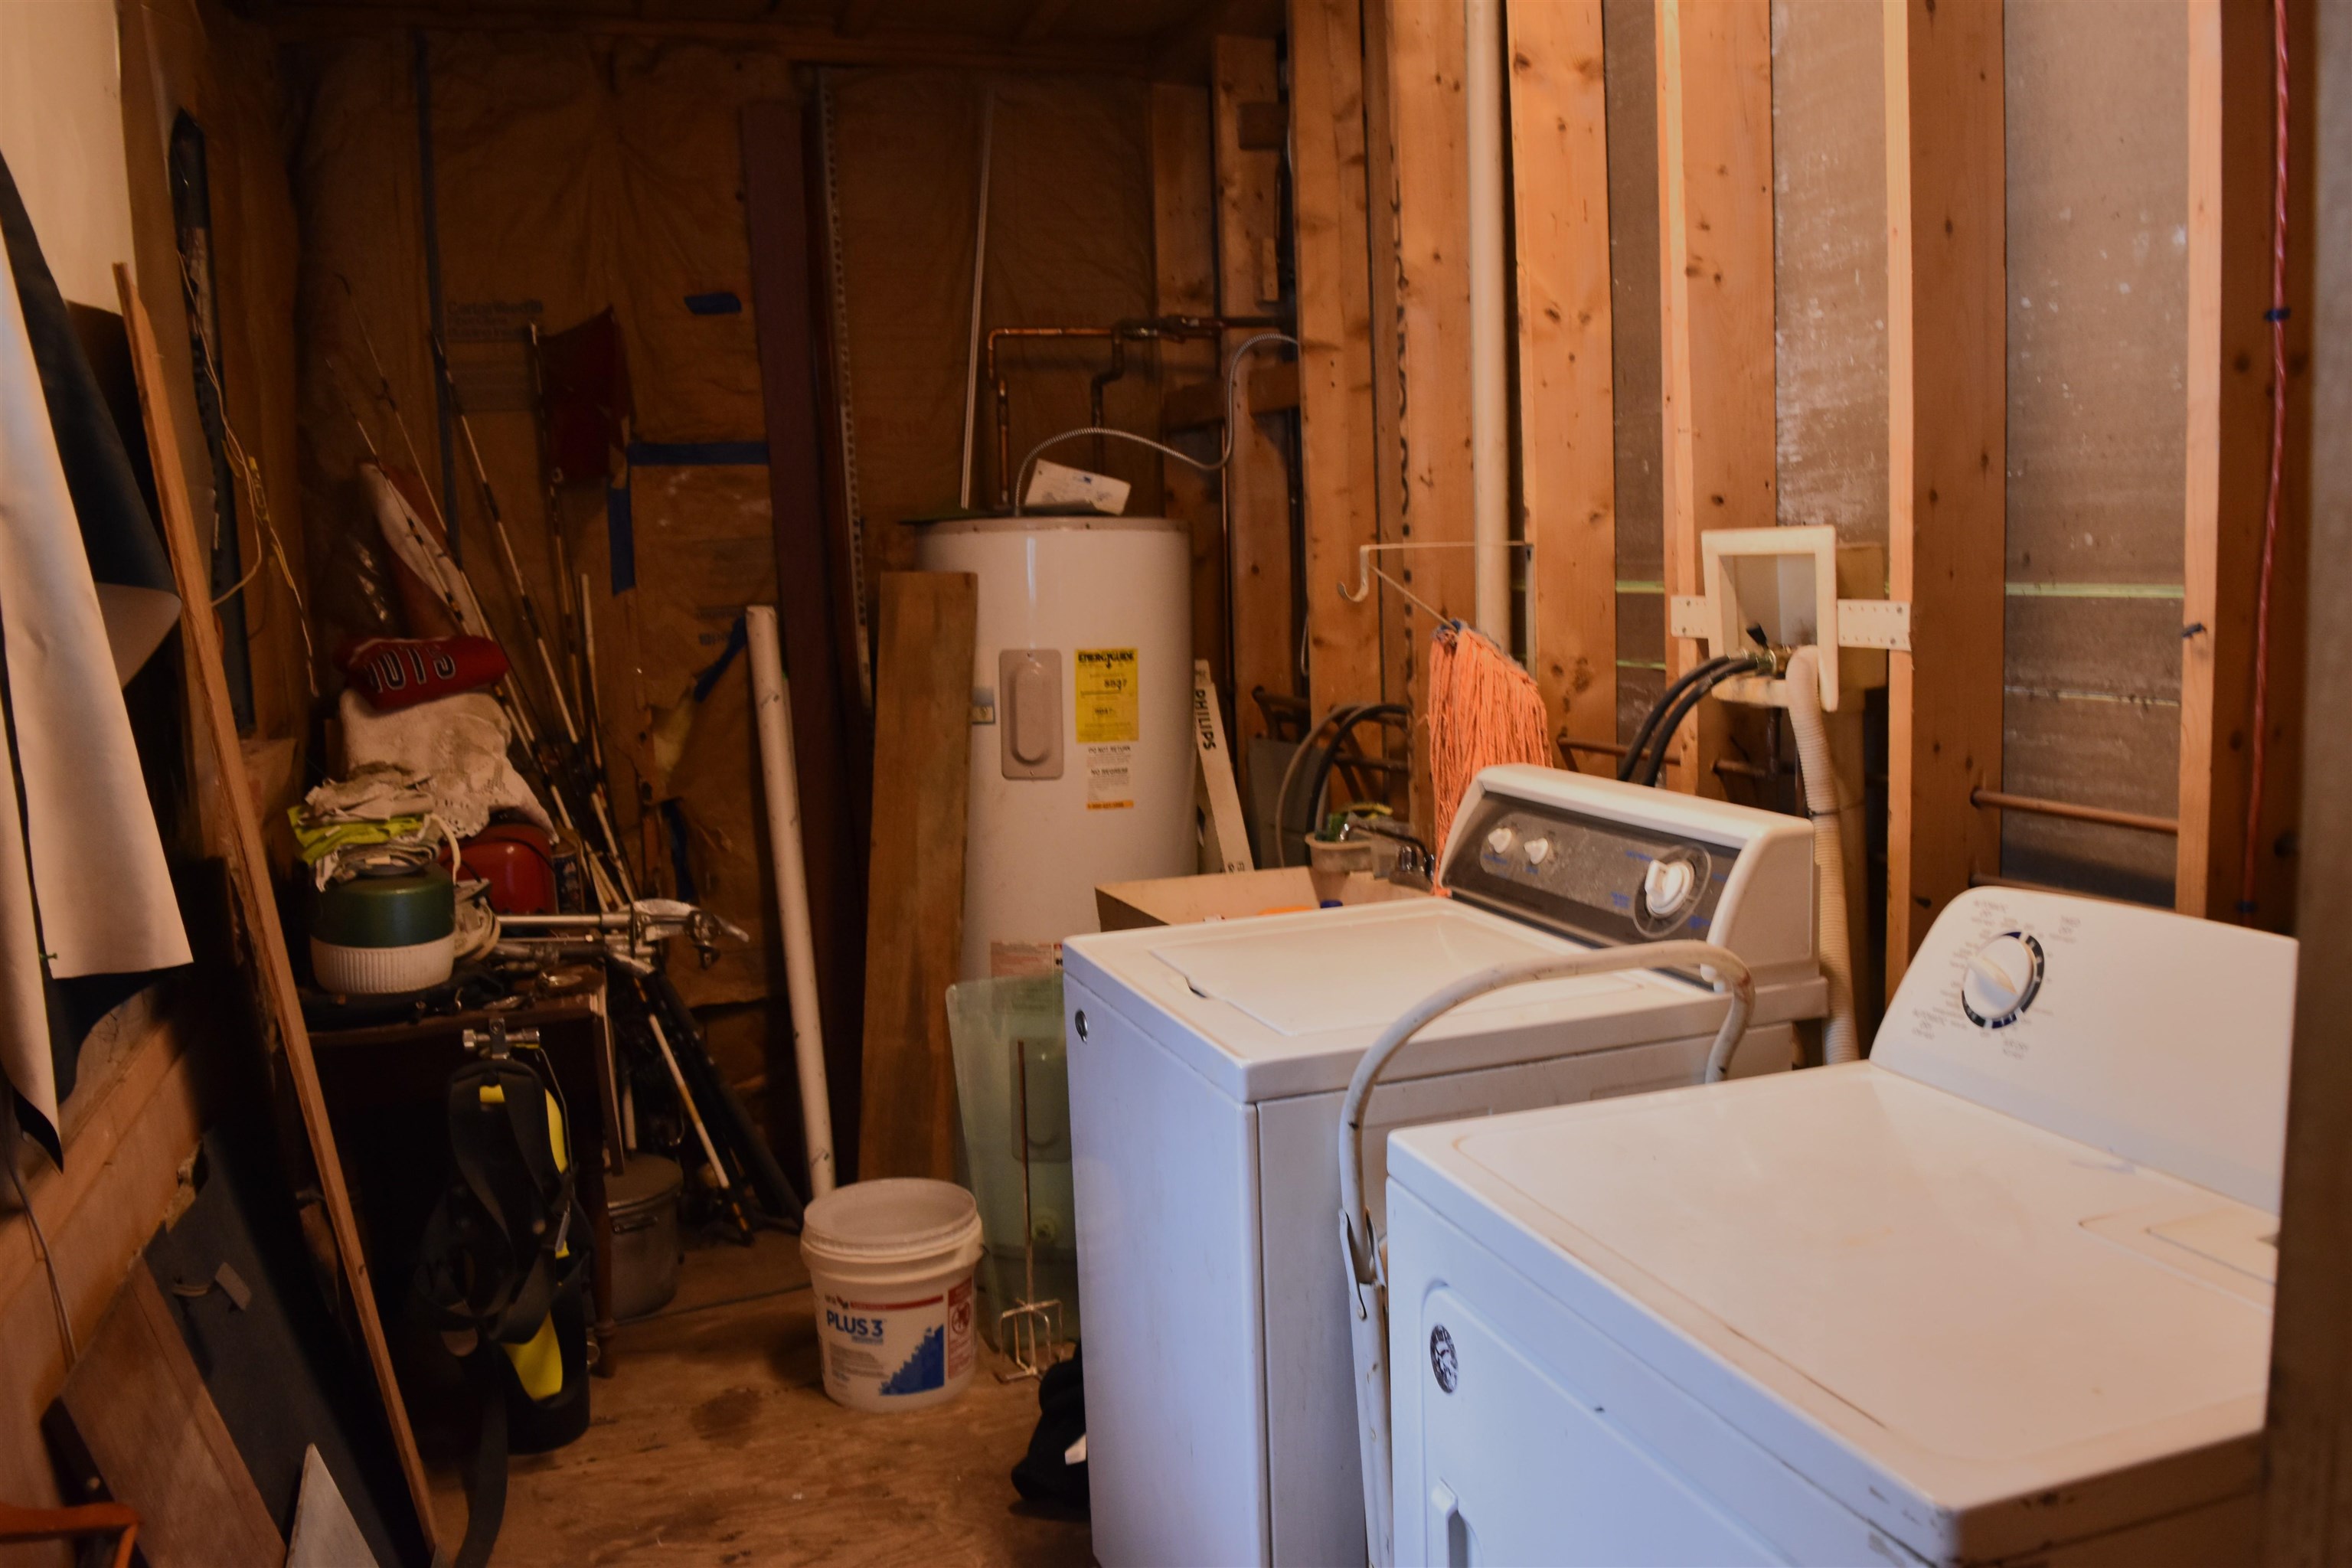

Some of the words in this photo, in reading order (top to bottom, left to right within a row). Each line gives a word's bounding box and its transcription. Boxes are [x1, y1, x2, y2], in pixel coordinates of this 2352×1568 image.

[1194, 690, 1216, 750] PHILIPS
[826, 1310, 868, 1335] PLUS
[871, 1319, 883, 1337] 3
